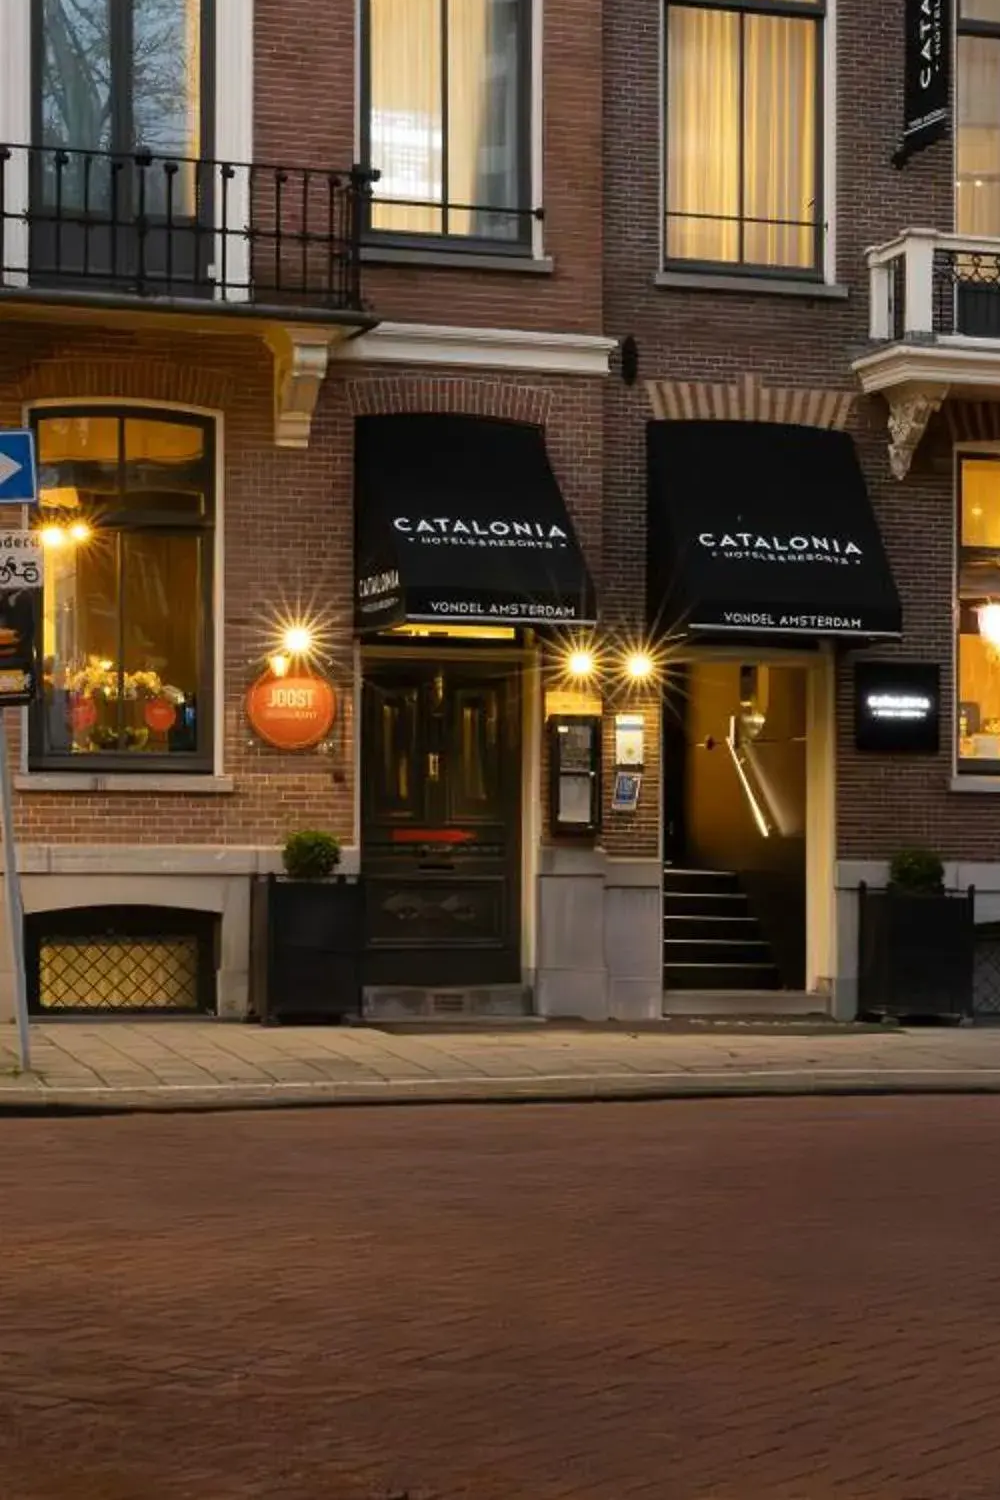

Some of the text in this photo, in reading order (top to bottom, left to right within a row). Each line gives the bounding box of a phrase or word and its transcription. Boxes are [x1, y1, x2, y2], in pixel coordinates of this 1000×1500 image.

[393, 517, 567, 539] CATALONIA
[698, 533, 863, 555] CATALONIA
[430, 601, 576, 617] VONDEL AMSTERDAM
[724, 612, 862, 629] VONDEL AMSTERDAM
[268, 688, 314, 708] JOOST
